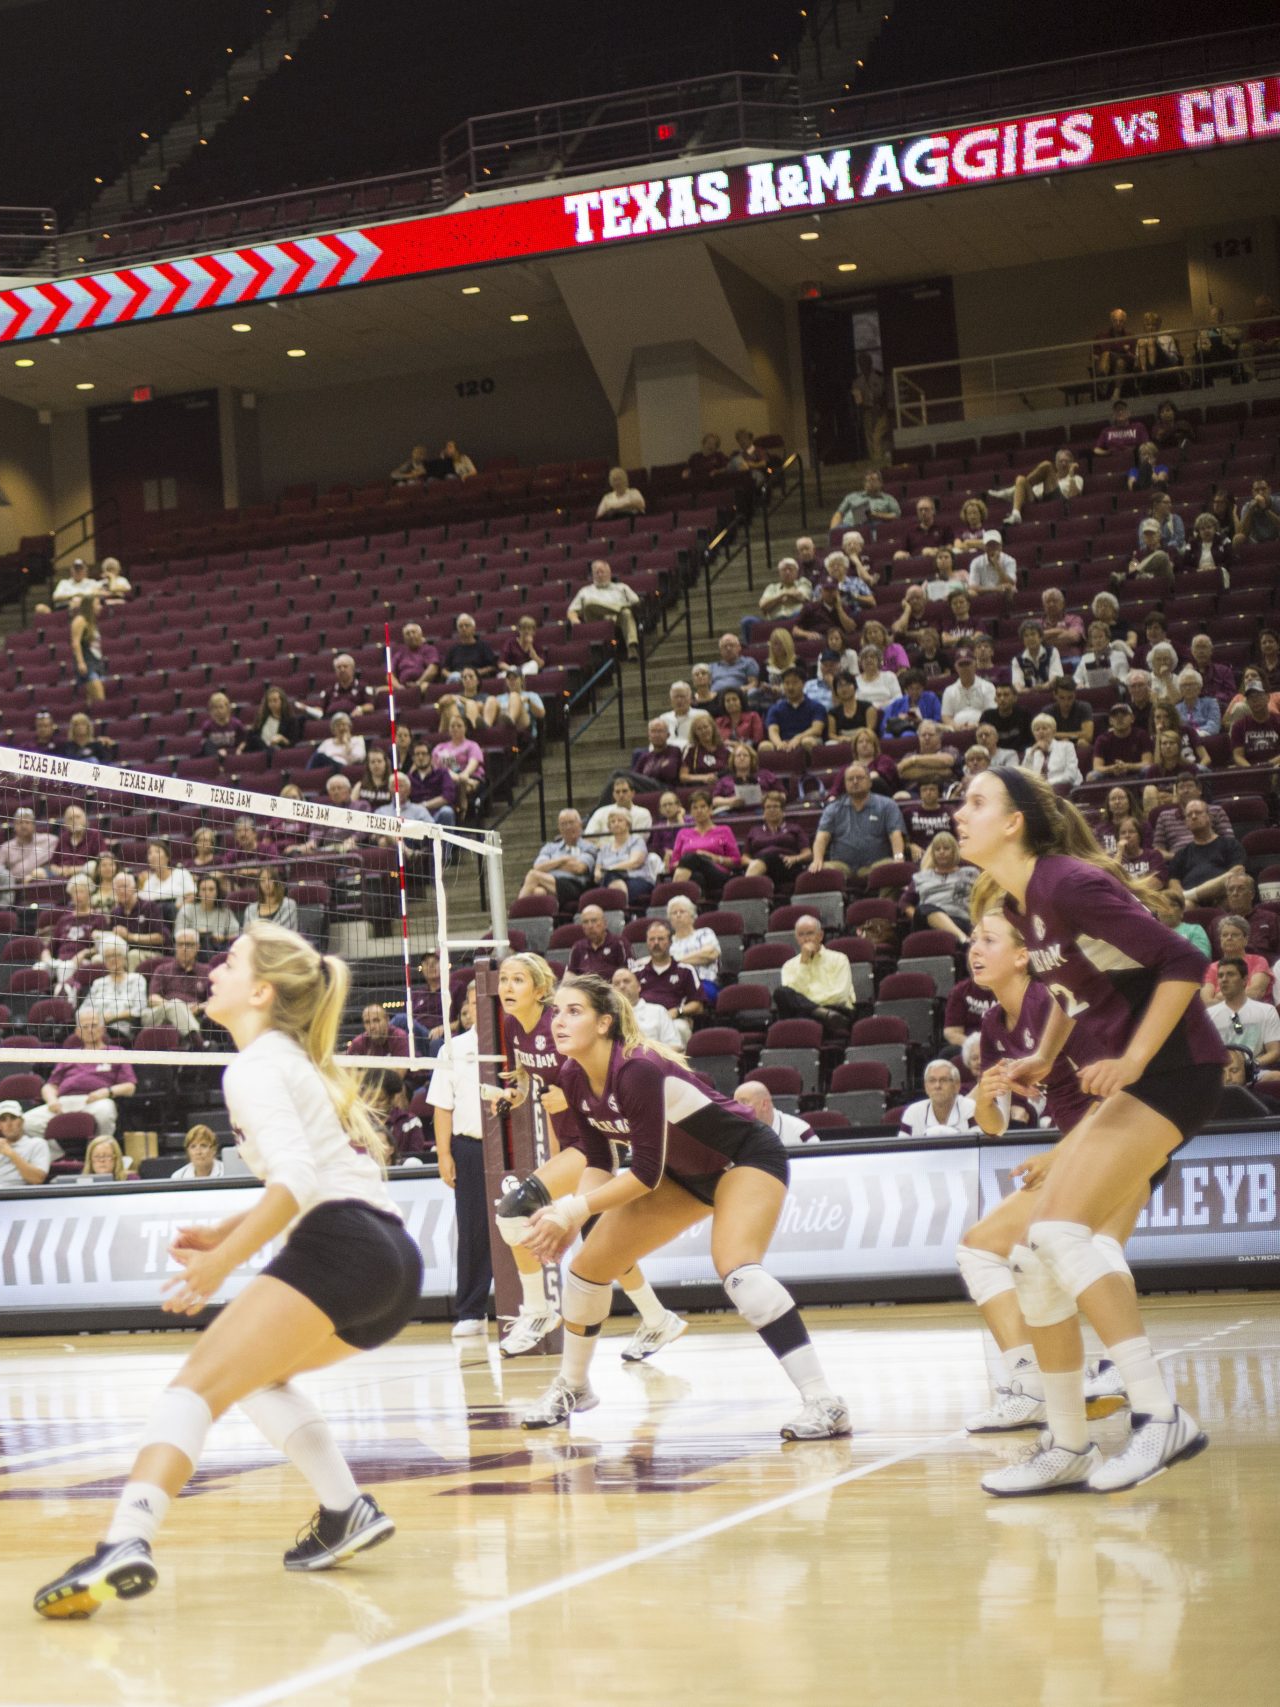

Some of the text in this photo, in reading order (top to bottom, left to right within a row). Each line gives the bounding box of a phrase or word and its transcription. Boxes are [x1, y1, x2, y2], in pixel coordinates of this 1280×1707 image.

[565, 171, 729, 243] TEXAS
[747, 149, 851, 215] A&M
[861, 113, 1093, 197] AGGIES
[454, 377, 495, 398] 120
[18, 753, 69, 777] TEXAS A&M
[119, 771, 165, 794] TEXAS A&M
[210, 788, 234, 805] TEXAS
[292, 802, 314, 819] TEXAS
[366, 815, 386, 830] TEXAS
[779, 1194, 846, 1234] hite
